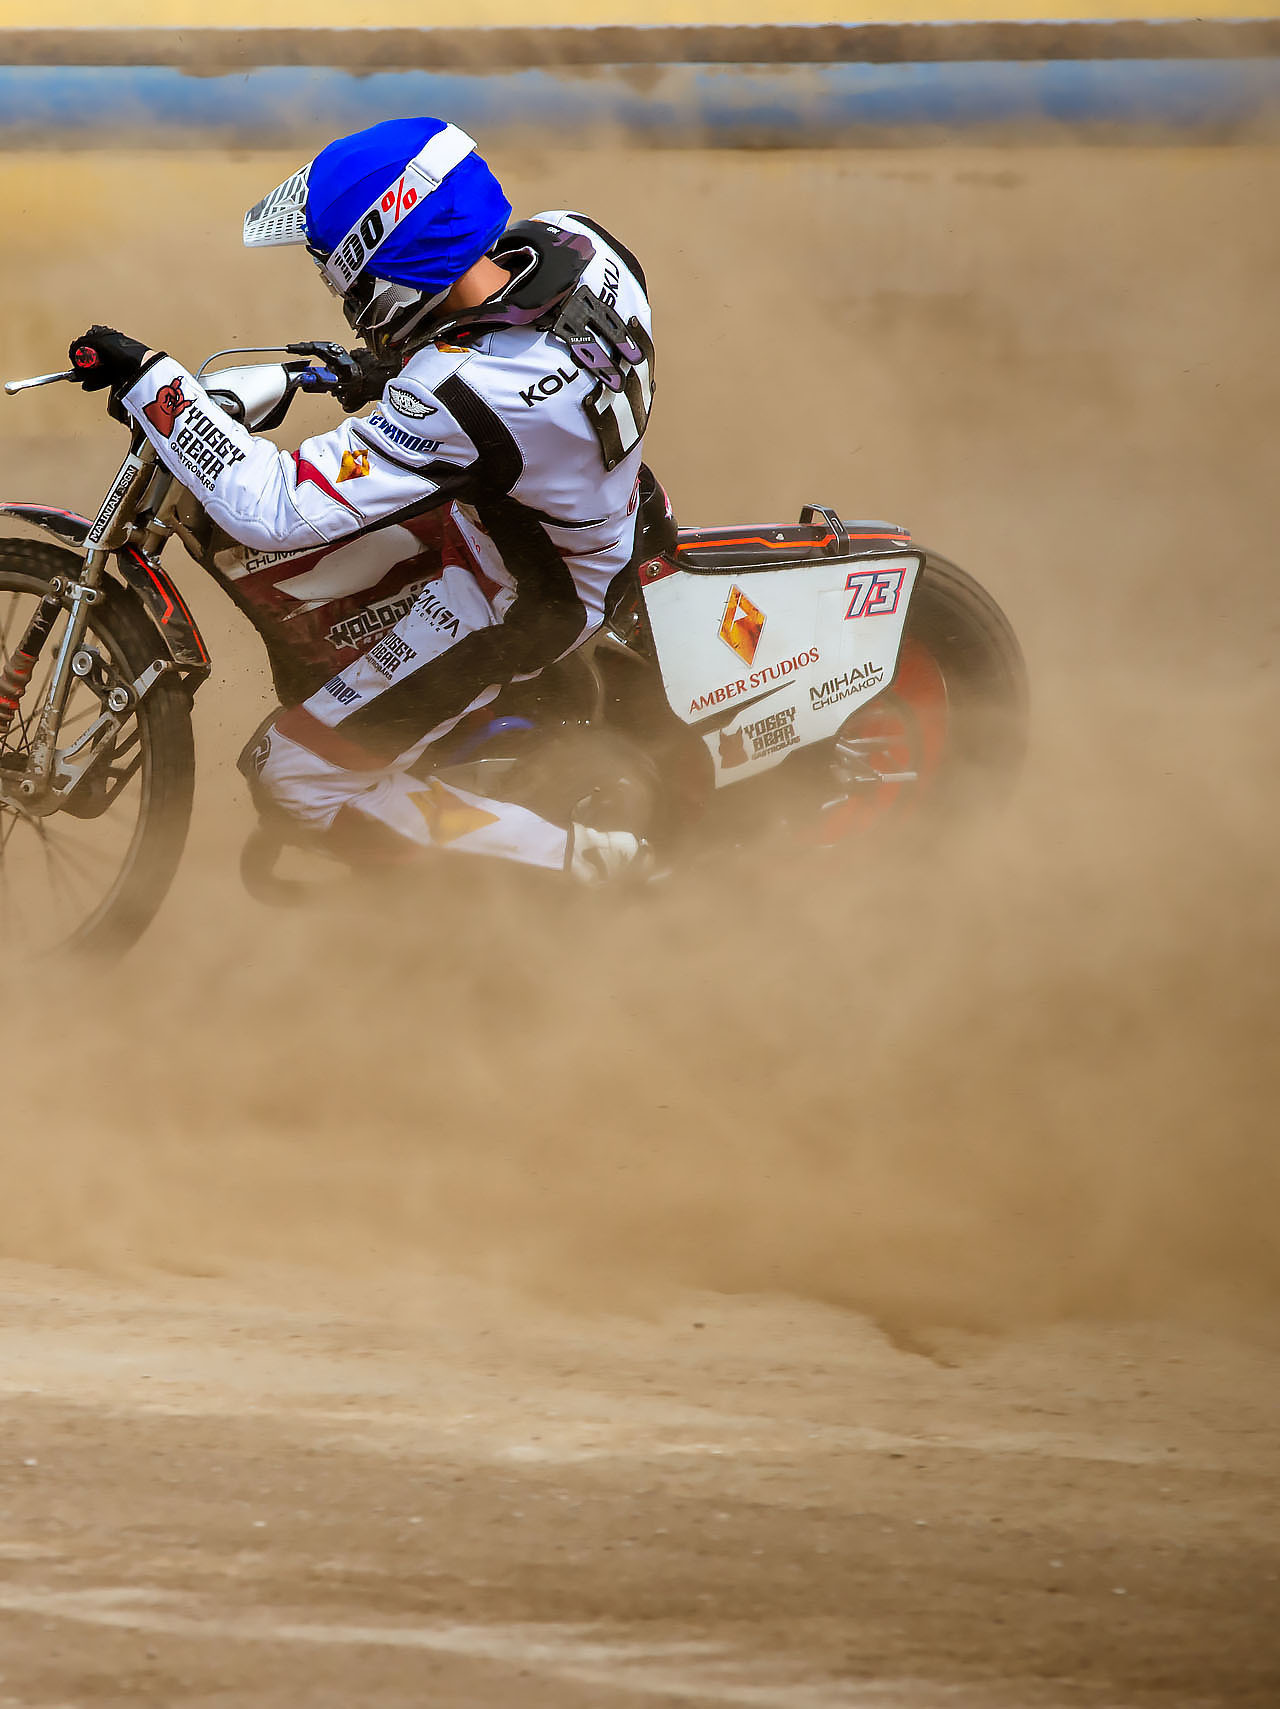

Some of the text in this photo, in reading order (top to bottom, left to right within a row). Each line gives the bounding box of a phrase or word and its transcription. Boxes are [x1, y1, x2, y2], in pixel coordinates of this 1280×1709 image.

[333, 177, 418, 283] 100%
[176, 426, 225, 481] BEAR
[184, 405, 247, 467] YOGGY
[170, 441, 216, 492] GASTROBARS
[843, 567, 908, 620] 73
[689, 647, 820, 715] AMBER STUDIOS
[809, 661, 884, 702] MIHAIL
[812, 671, 885, 711] CHUMAKOV
[743, 706, 797, 739] YOGGY
[751, 723, 796, 753] BEAR
